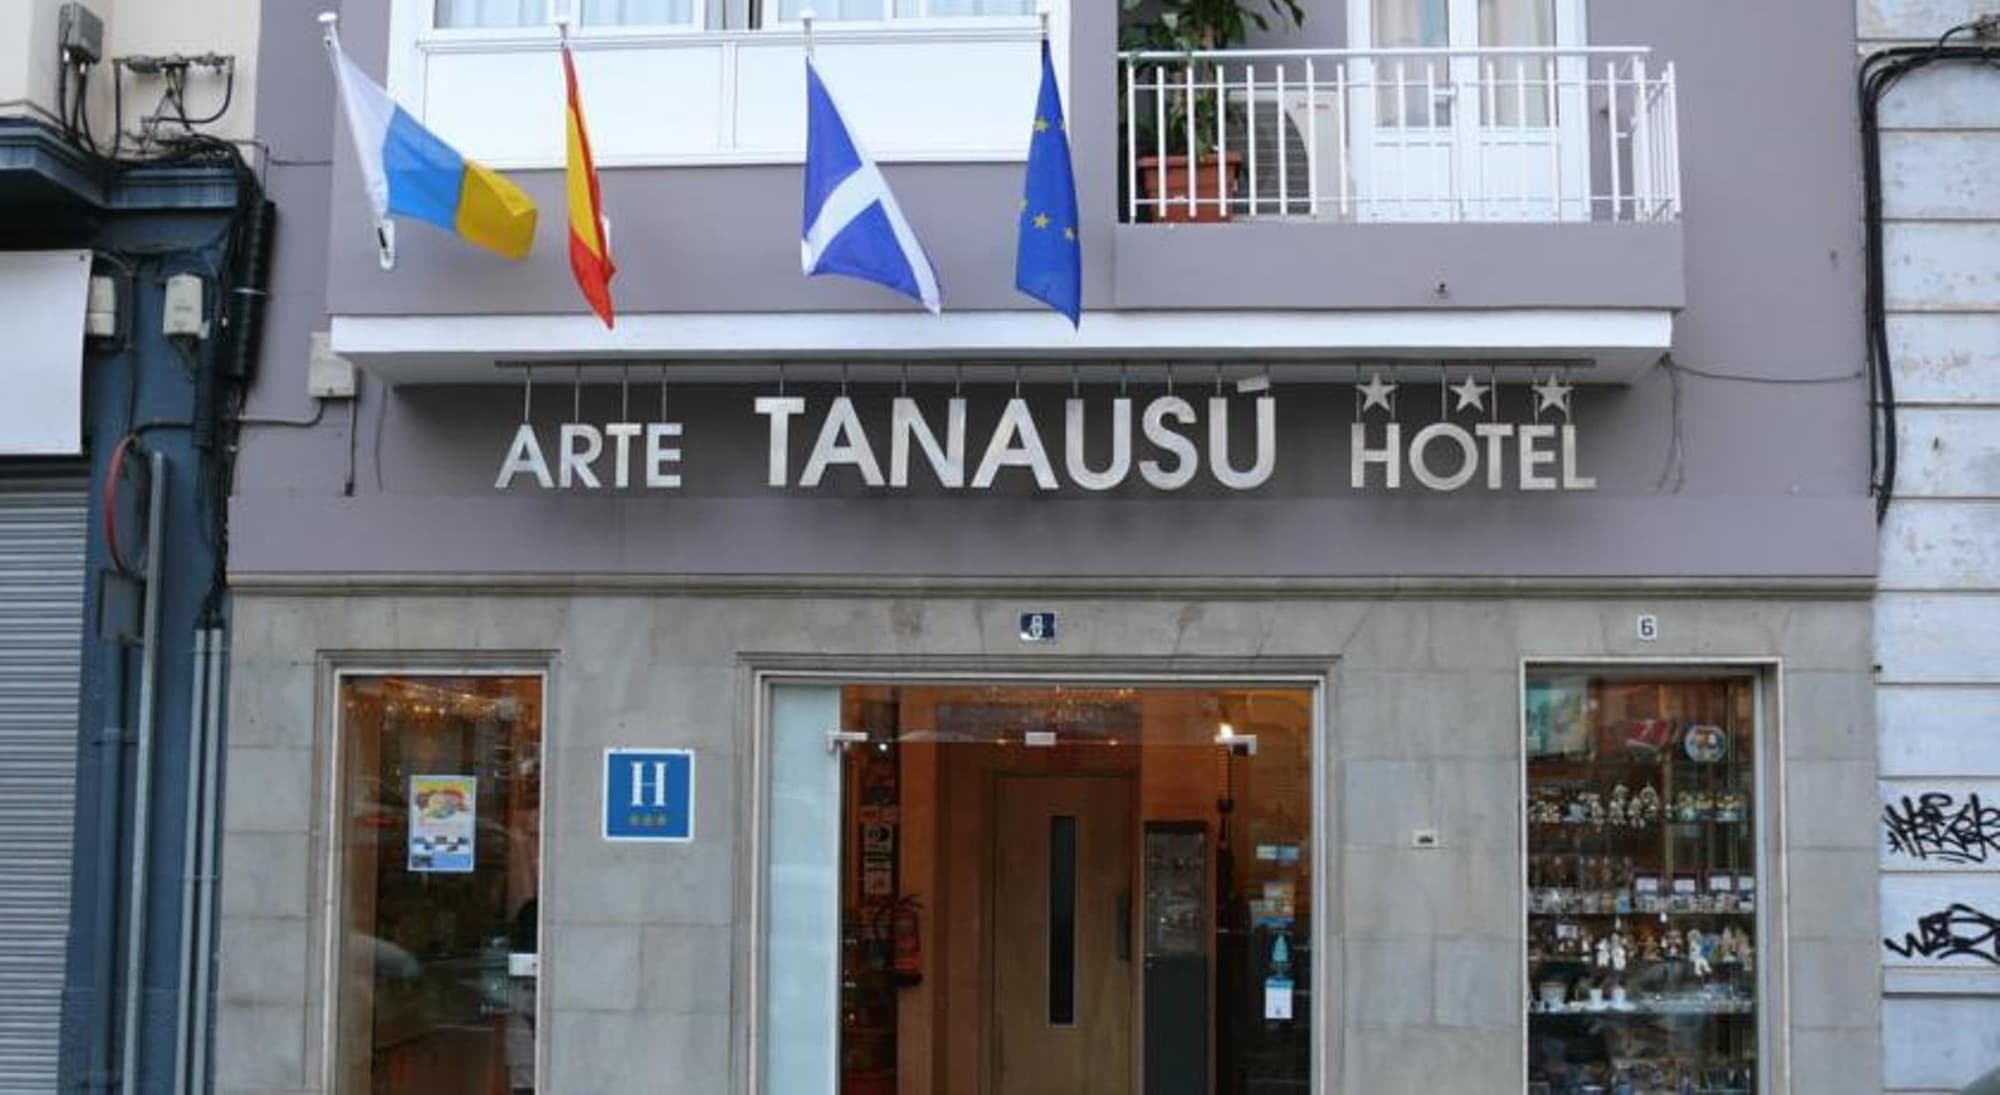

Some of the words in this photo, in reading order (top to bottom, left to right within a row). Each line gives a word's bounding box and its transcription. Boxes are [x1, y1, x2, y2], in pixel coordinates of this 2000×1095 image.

[495, 422, 682, 489] ARTE
[1350, 421, 1598, 491] HOTEL
[1641, 618, 1654, 636] 6
[630, 760, 669, 807] H
